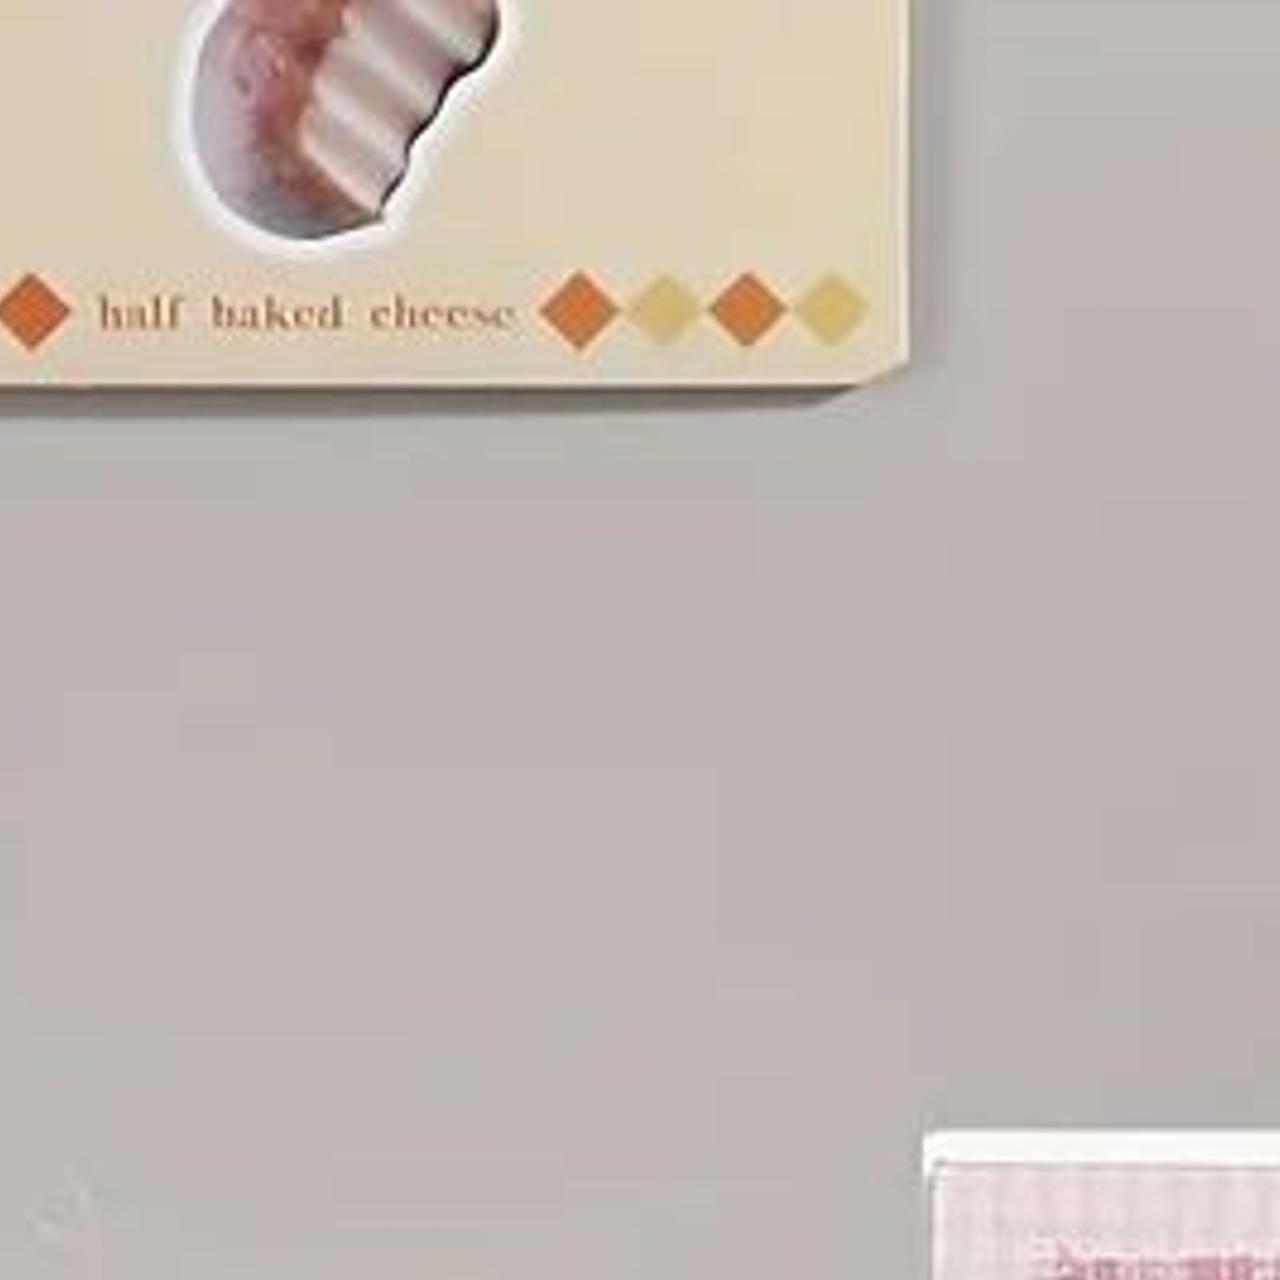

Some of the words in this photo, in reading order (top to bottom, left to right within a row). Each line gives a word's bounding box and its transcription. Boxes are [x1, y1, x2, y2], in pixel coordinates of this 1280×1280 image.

[97, 293, 184, 330] half
[211, 293, 344, 330] baked
[369, 293, 517, 330] cheese
